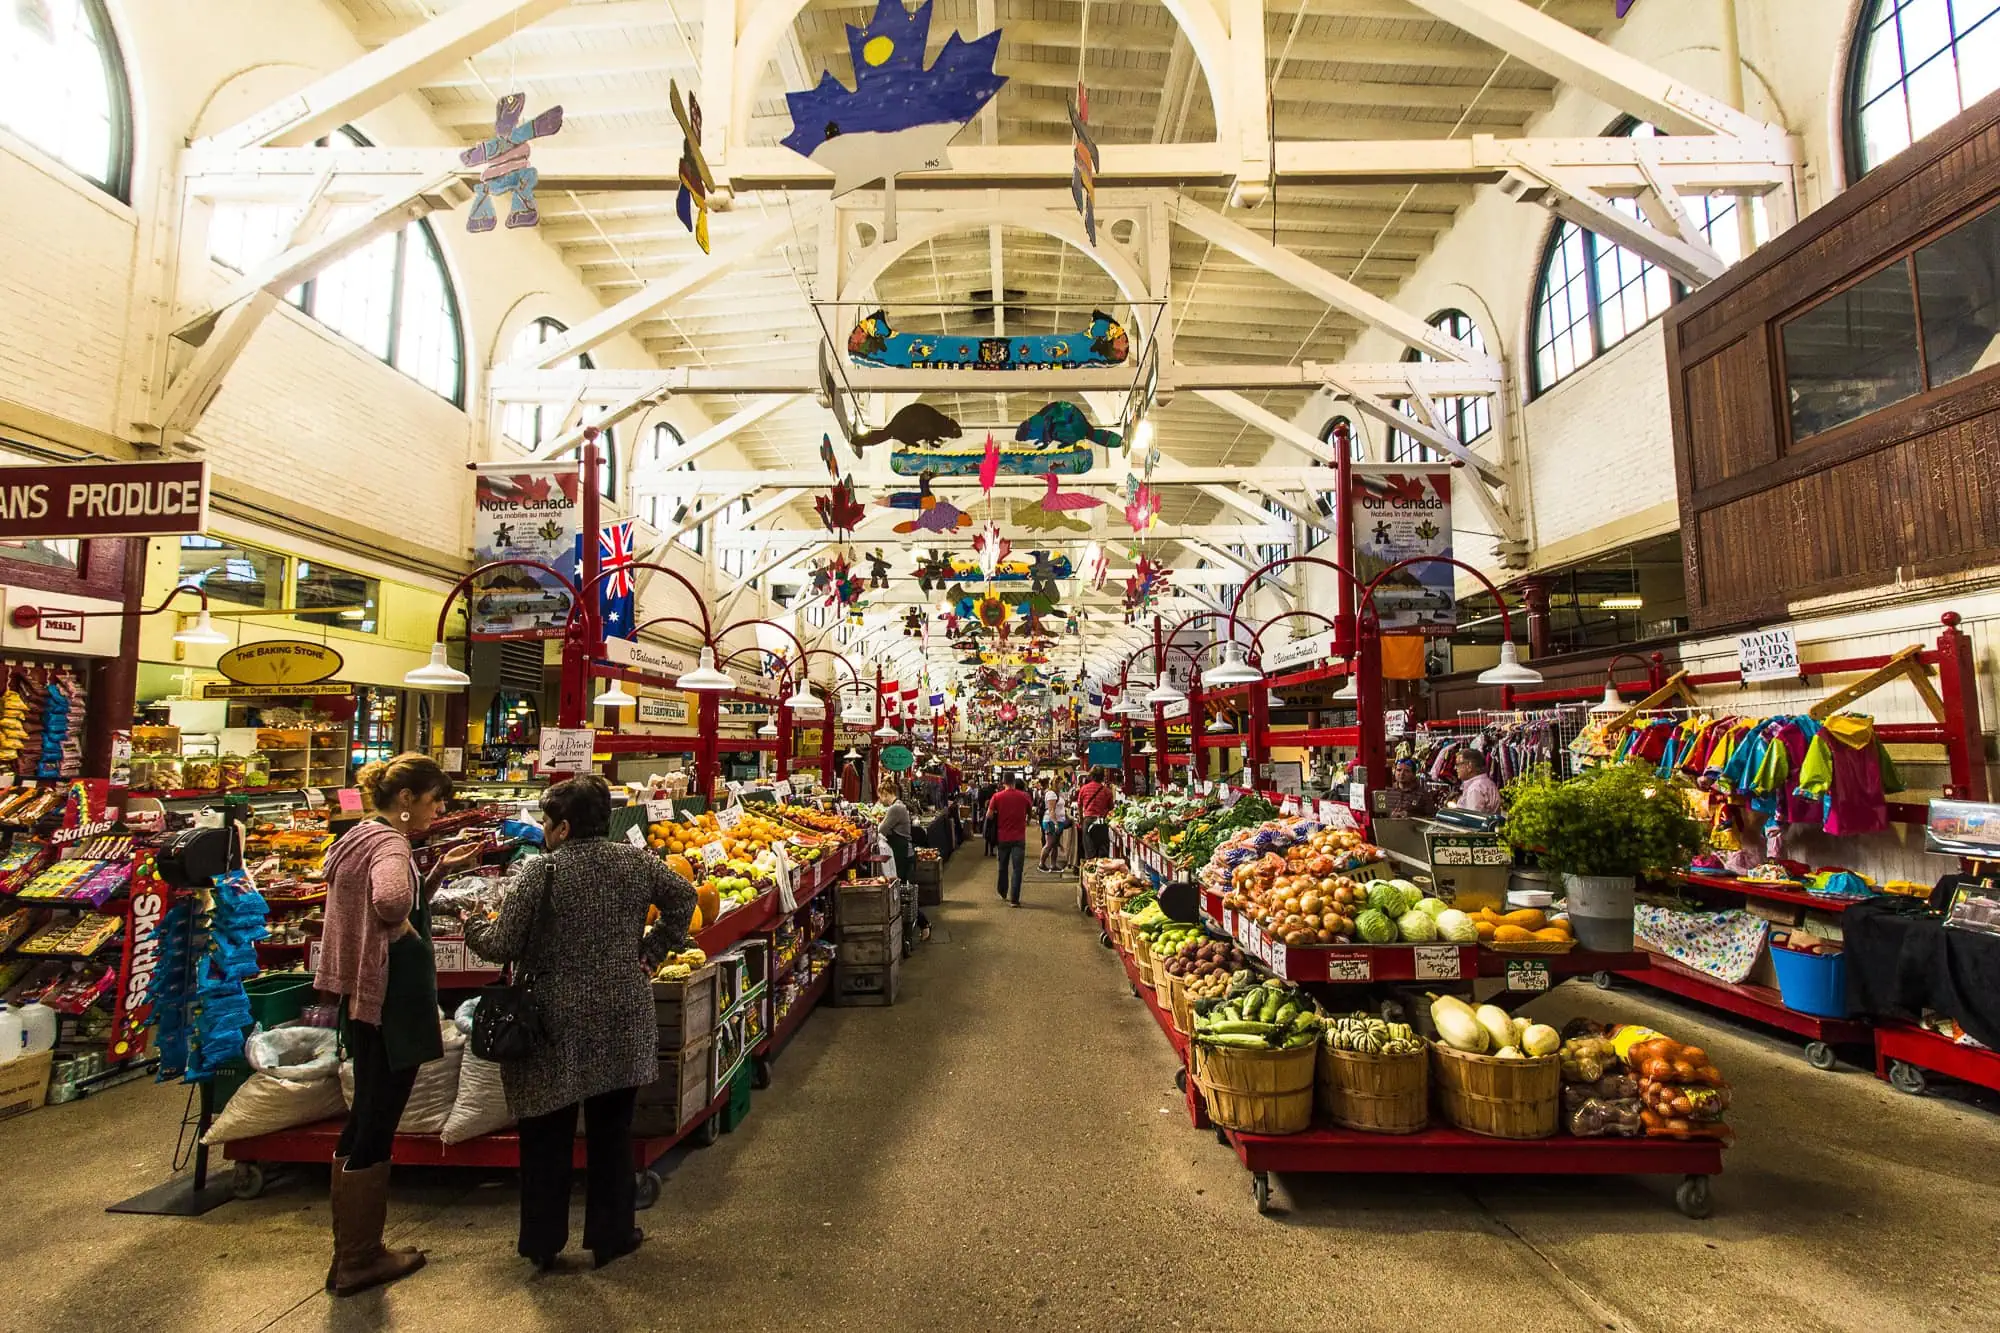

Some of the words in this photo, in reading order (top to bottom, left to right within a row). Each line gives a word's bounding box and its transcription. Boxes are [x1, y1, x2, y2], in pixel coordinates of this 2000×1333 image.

[67, 480, 200, 518] PRODUCE
[479, 499, 519, 512] Notre
[522, 496, 574, 511] Canada
[1362, 496, 1386, 510] Our
[1391, 496, 1443, 510] Canada
[45, 619, 77, 632] Milk
[1741, 631, 1789, 648] MAINLY
[236, 650, 255, 661] THE
[257, 646, 291, 657] BAKING
[294, 646, 325, 660] STONE
[1745, 650, 1756, 658] for
[1759, 644, 1790, 657] KIDS
[543, 737, 564, 752] Cold
[566, 737, 592, 750] Drinks
[51, 821, 112, 844] Skittles
[125, 894, 162, 1010] Skittles
